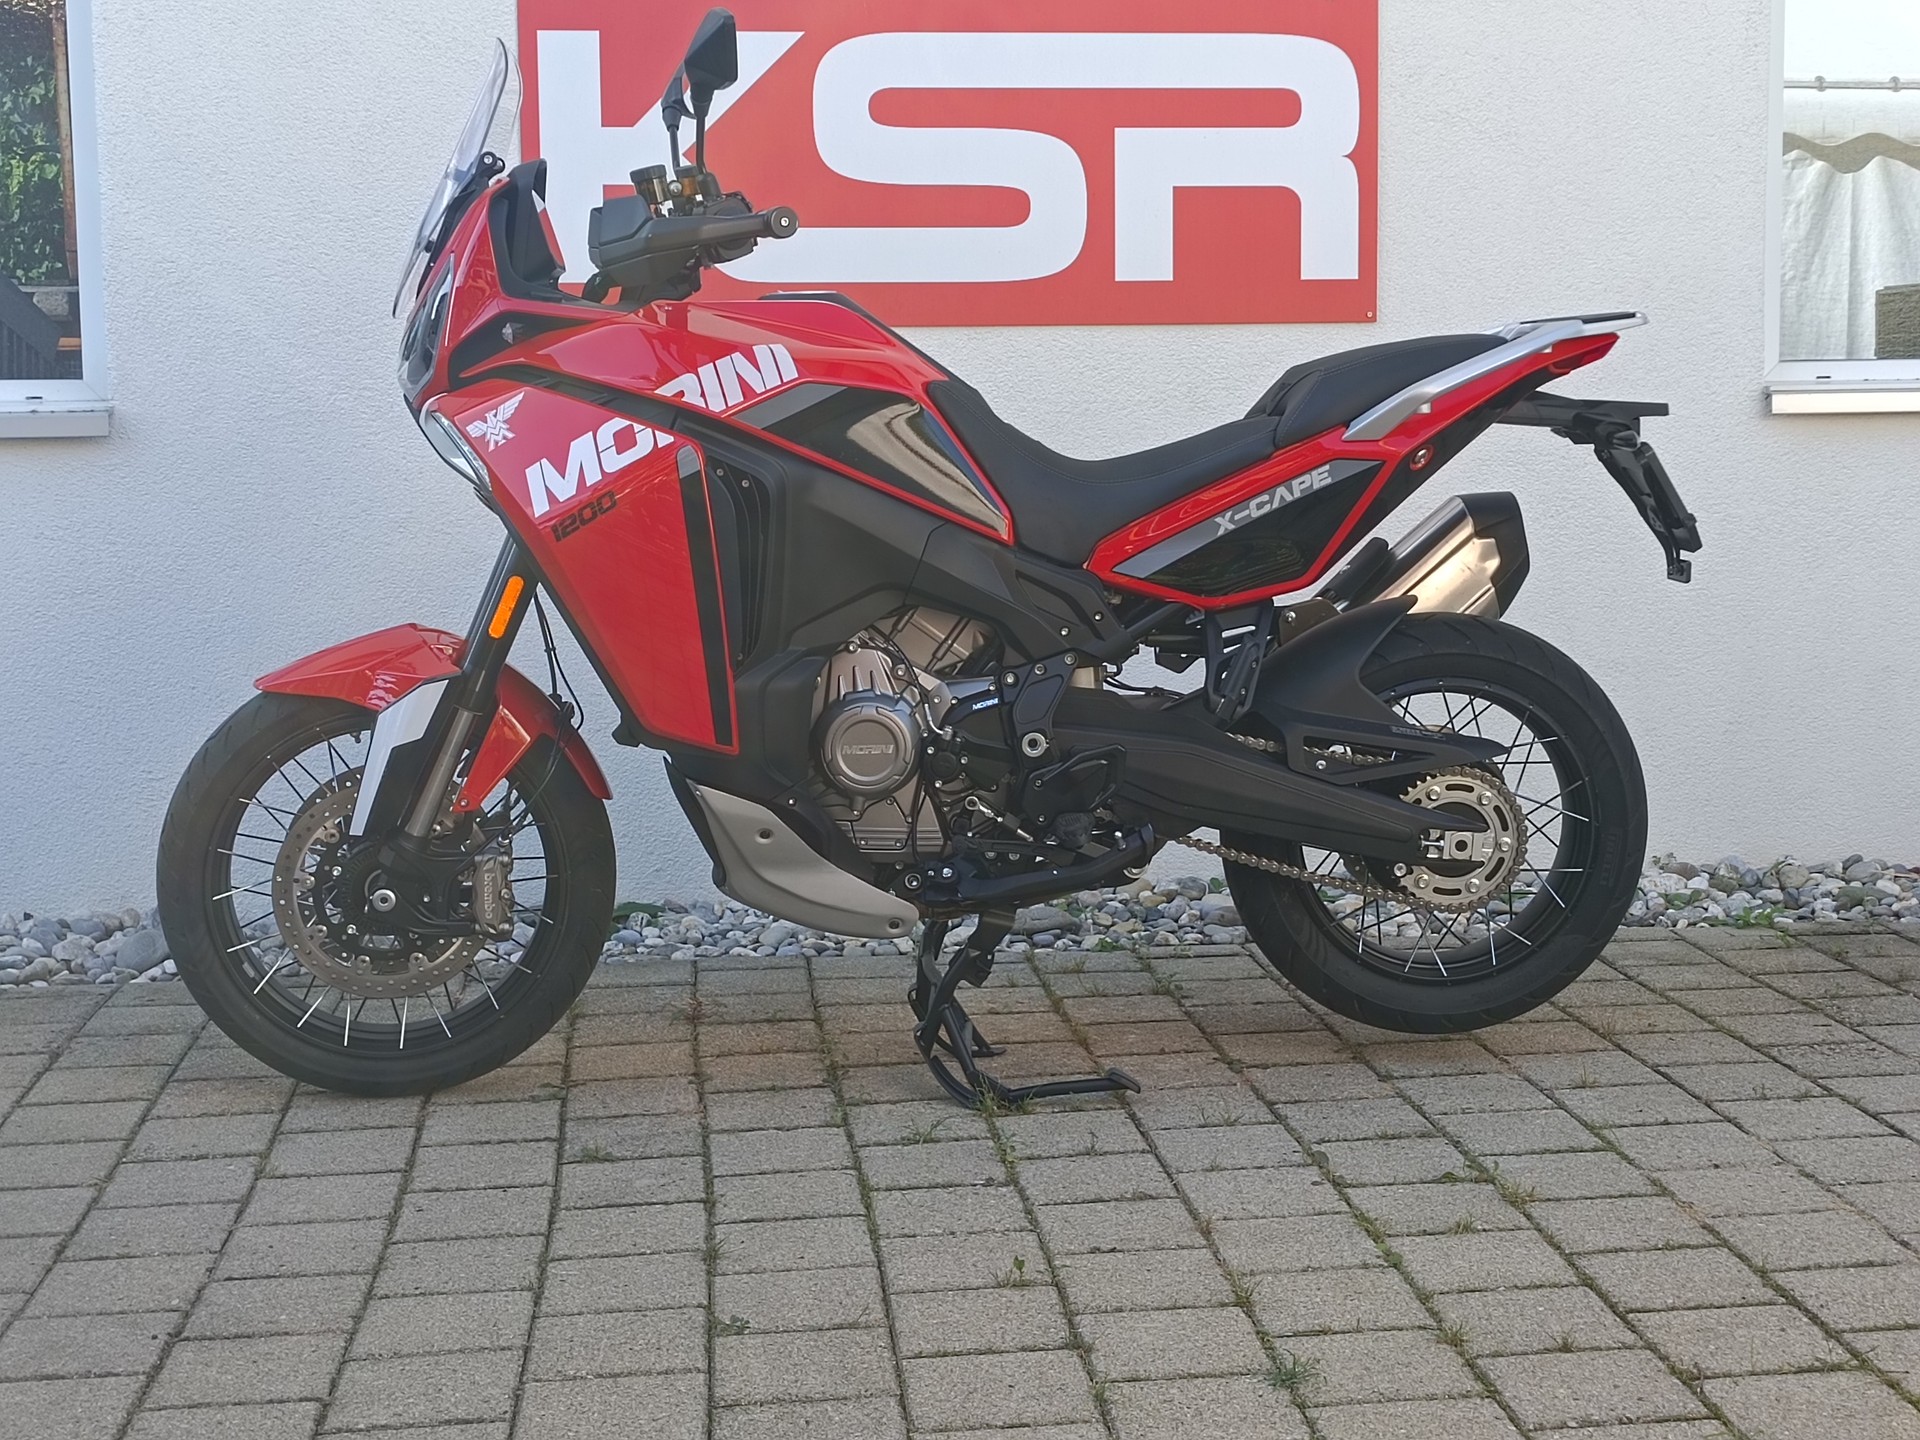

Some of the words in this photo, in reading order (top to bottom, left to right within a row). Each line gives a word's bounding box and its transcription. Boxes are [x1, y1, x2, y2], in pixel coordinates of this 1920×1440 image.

[536, 29, 1360, 284] KSR
[551, 490, 618, 543] 1200
[1214, 464, 1332, 536] X-CAPE
[842, 744, 895, 755] MORINI
[484, 872, 496, 920] brembo
